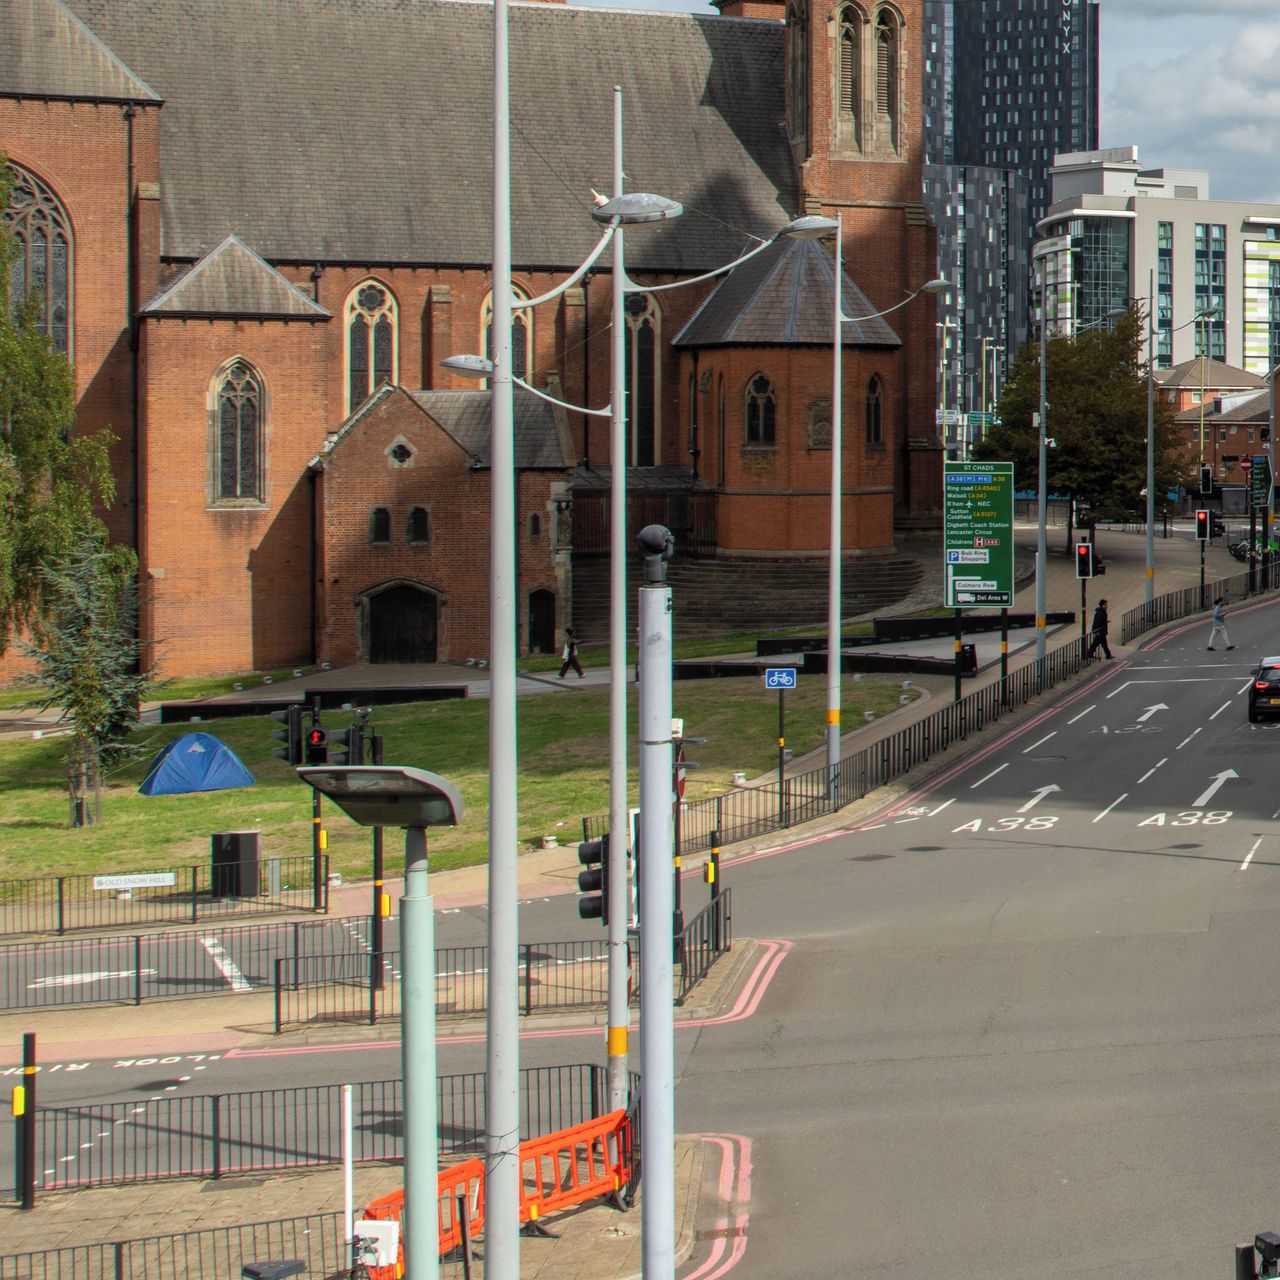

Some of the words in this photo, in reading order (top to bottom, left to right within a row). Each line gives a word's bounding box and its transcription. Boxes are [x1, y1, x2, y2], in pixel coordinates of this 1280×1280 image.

[952, 816, 1060, 833] A38
[1137, 810, 1234, 828] A38
[123, 877, 147, 885] SNOW
[149, 876, 165, 884] HILL
[112, 1055, 206, 1069] LOOK
